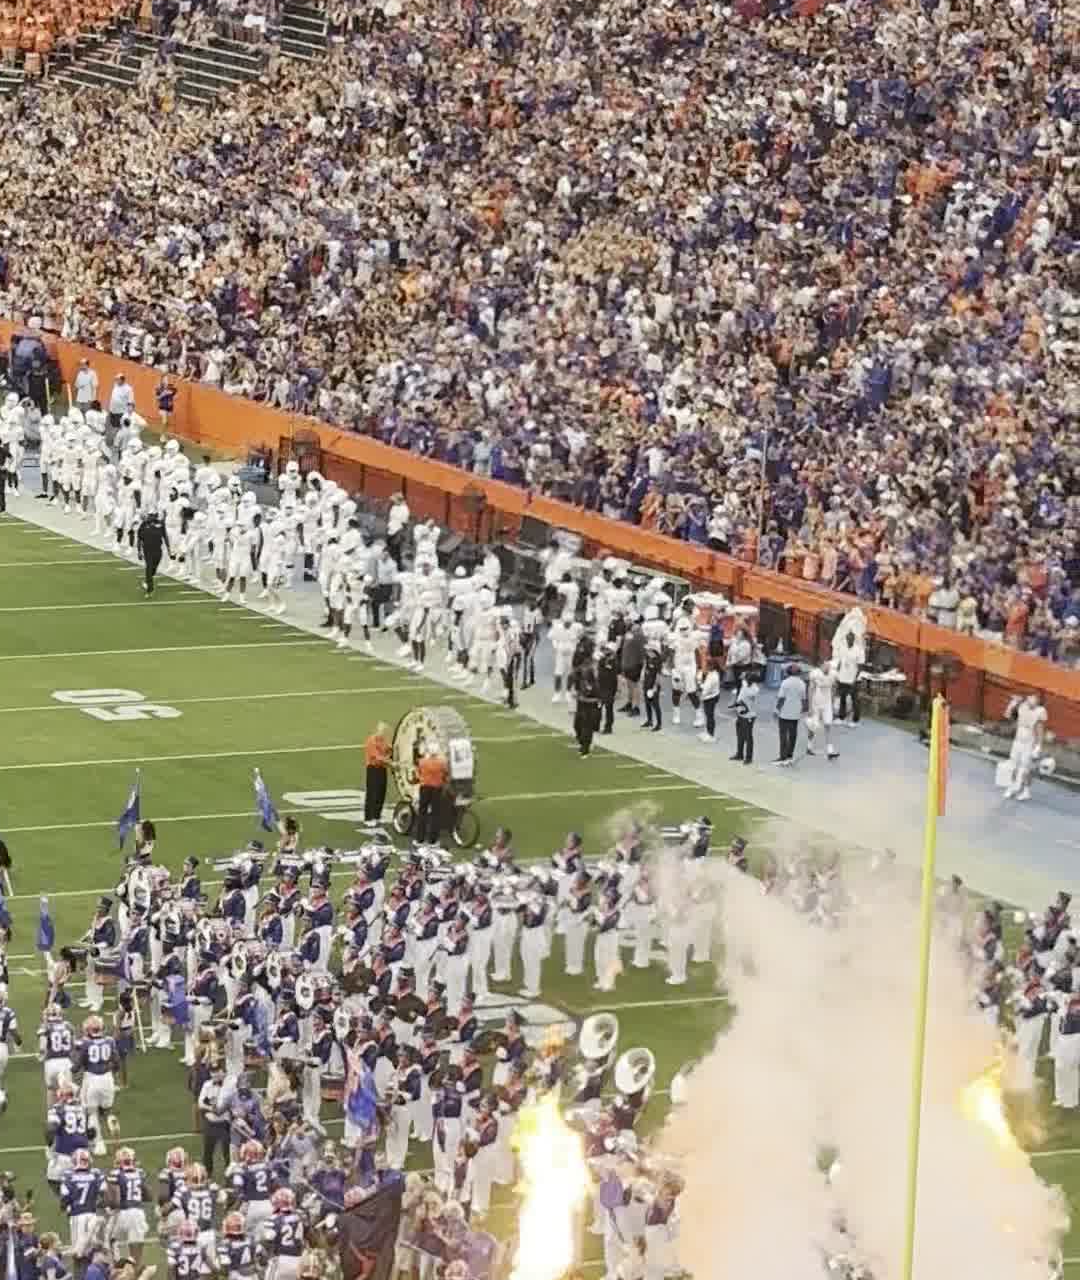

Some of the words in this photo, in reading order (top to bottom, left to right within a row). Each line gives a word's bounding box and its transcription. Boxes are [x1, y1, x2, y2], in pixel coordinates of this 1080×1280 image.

[49, 688, 185, 722] 50
[65, 1111, 87, 1134] 93
[126, 1179, 142, 1201] 15
[255, 1170, 268, 1192] 2
[77, 1182, 90, 1205] 7
[186, 1197, 213, 1221] 96
[280, 1222, 304, 1246] 24
[177, 1255, 203, 1275] 34
